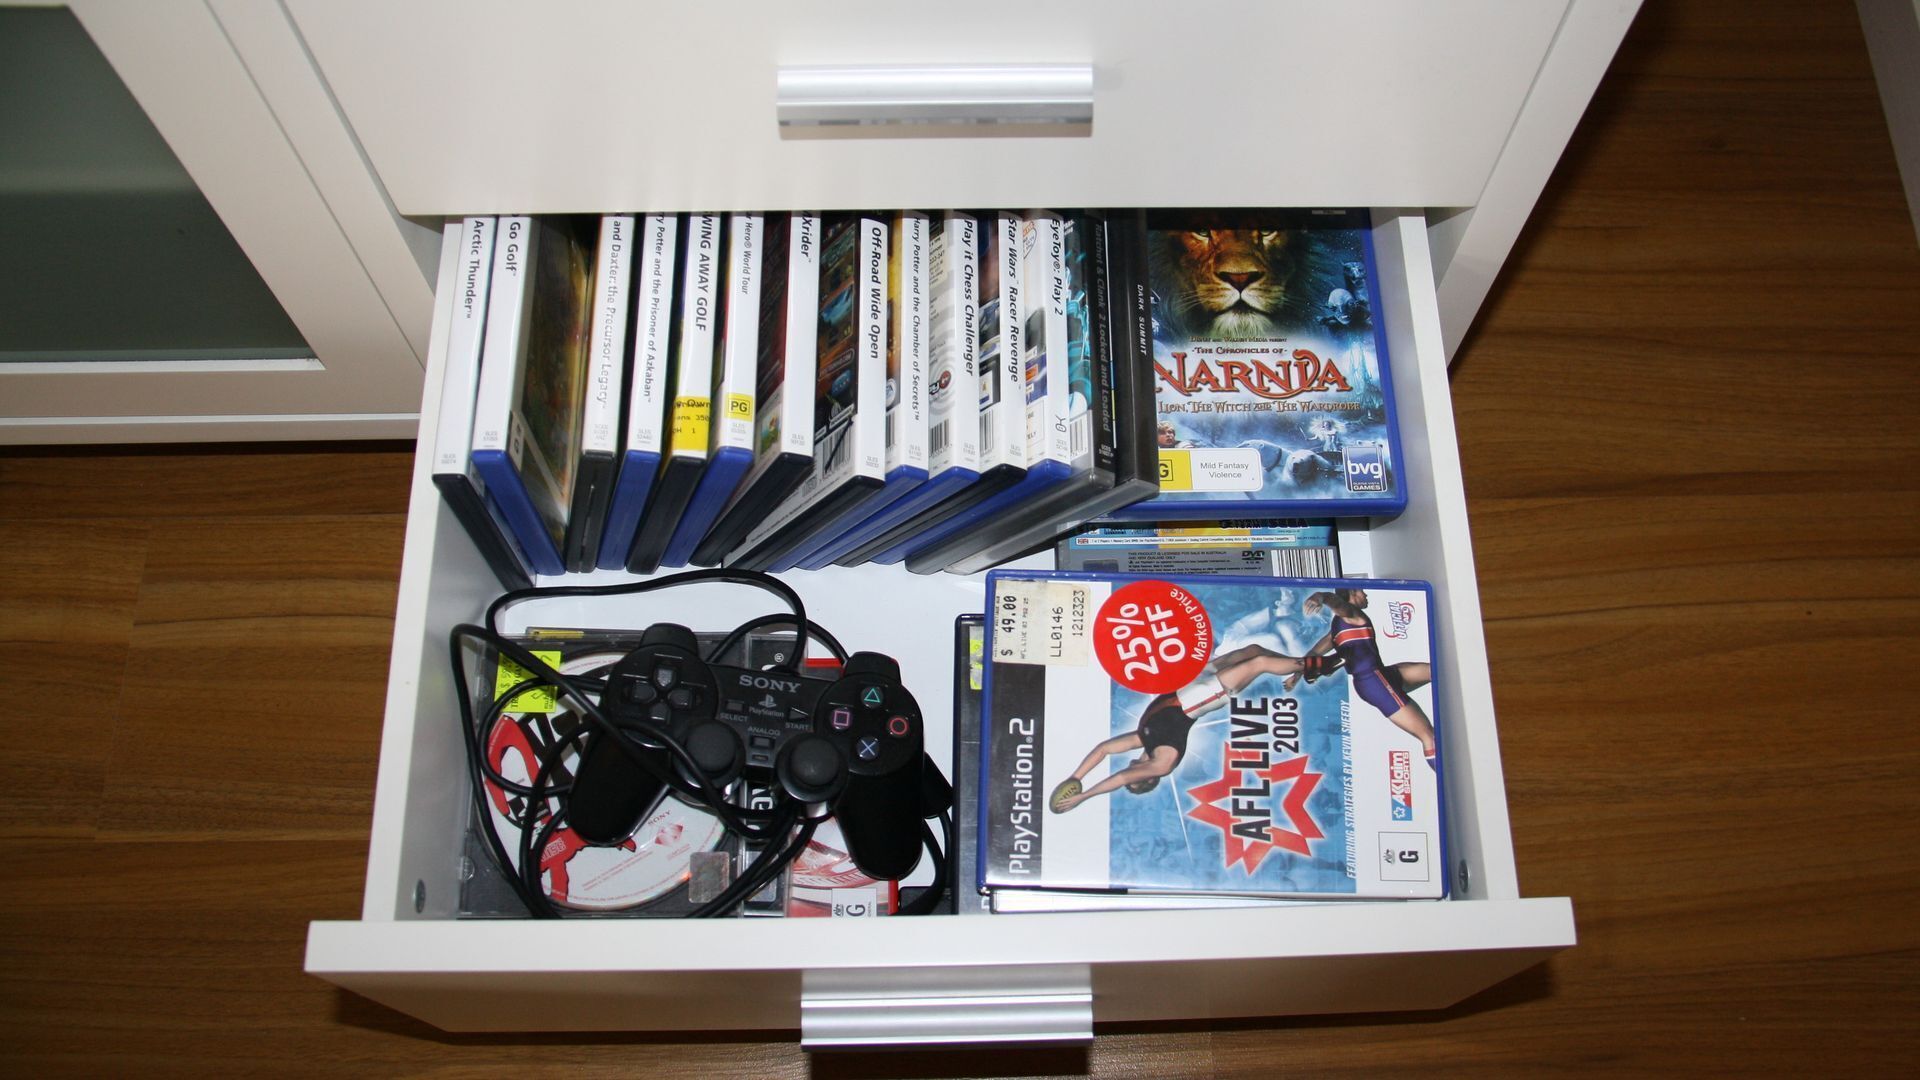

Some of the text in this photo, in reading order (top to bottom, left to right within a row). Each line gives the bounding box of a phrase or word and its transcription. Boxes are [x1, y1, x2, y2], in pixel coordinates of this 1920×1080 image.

[471, 220, 485, 255] Arctic
[509, 221, 521, 239] Go
[612, 220, 622, 241] and
[655, 226, 666, 256] Potter
[912, 216, 921, 243] Harry
[1008, 218, 1017, 244] Star
[608, 244, 622, 284] Daxter:
[653, 258, 662, 277] and
[695, 211, 713, 331] WING AWAY GOLF
[742, 250, 752, 275] World
[913, 244, 921, 274] Potter
[607, 284, 618, 303] the
[652, 279, 661, 295] the
[741, 276, 751, 295] Tour
[868, 227, 882, 359] Off-Road Wide Open
[913, 275, 921, 295] and
[962, 219, 976, 376] Play it Chess Challenger
[1051, 276, 1063, 305] Play
[1097, 278, 1106, 308] Clank
[649, 297, 660, 337] Prisoner
[913, 298, 921, 312] the
[1009, 286, 1018, 322] Racer
[1054, 307, 1063, 316] 2
[602, 307, 616, 360] Precursor
[1137, 284, 1147, 356] DARK SUMMIT
[648, 341, 657, 352] of
[912, 315, 921, 357] Chamber
[1099, 323, 1108, 363] Locked
[1216, 346, 1270, 354] CHRONICLES
[912, 361, 921, 373] of
[1101, 366, 1109, 387] and
[1153, 349, 1353, 399] NARNIA
[730, 400, 748, 413] PG
[1101, 388, 1112, 432] Loaded
[1212, 401, 1250, 413] WITCH
[1200, 462, 1250, 471] Mild Fantasy
[1208, 471, 1242, 479] Violence
[1347, 460, 1383, 478] bvg
[1002, 595, 1017, 634] 49.00
[1072, 589, 1085, 637] 1212323
[1170, 588, 1208, 661] Marked Price
[1049, 606, 1064, 658] LL0146
[1106, 603, 1160, 681] 25%
[1145, 603, 1186, 663] OFF
[739, 674, 801, 693] SONY
[720, 712, 748, 723] SELECT
[749, 705, 785, 718] PlayStation
[747, 725, 781, 736] ANALOG
[785, 722, 810, 731] START
[1272, 697, 1299, 754] 2003
[1229, 696, 1272, 843] AFL LIVE
[1402, 752, 1411, 794] SPORTS
[1340, 699, 1357, 880] FEATURING STRATEGIES BY KEVIN SHEEDY
[1398, 850, 1419, 863] G
[845, 904, 866, 917] G
